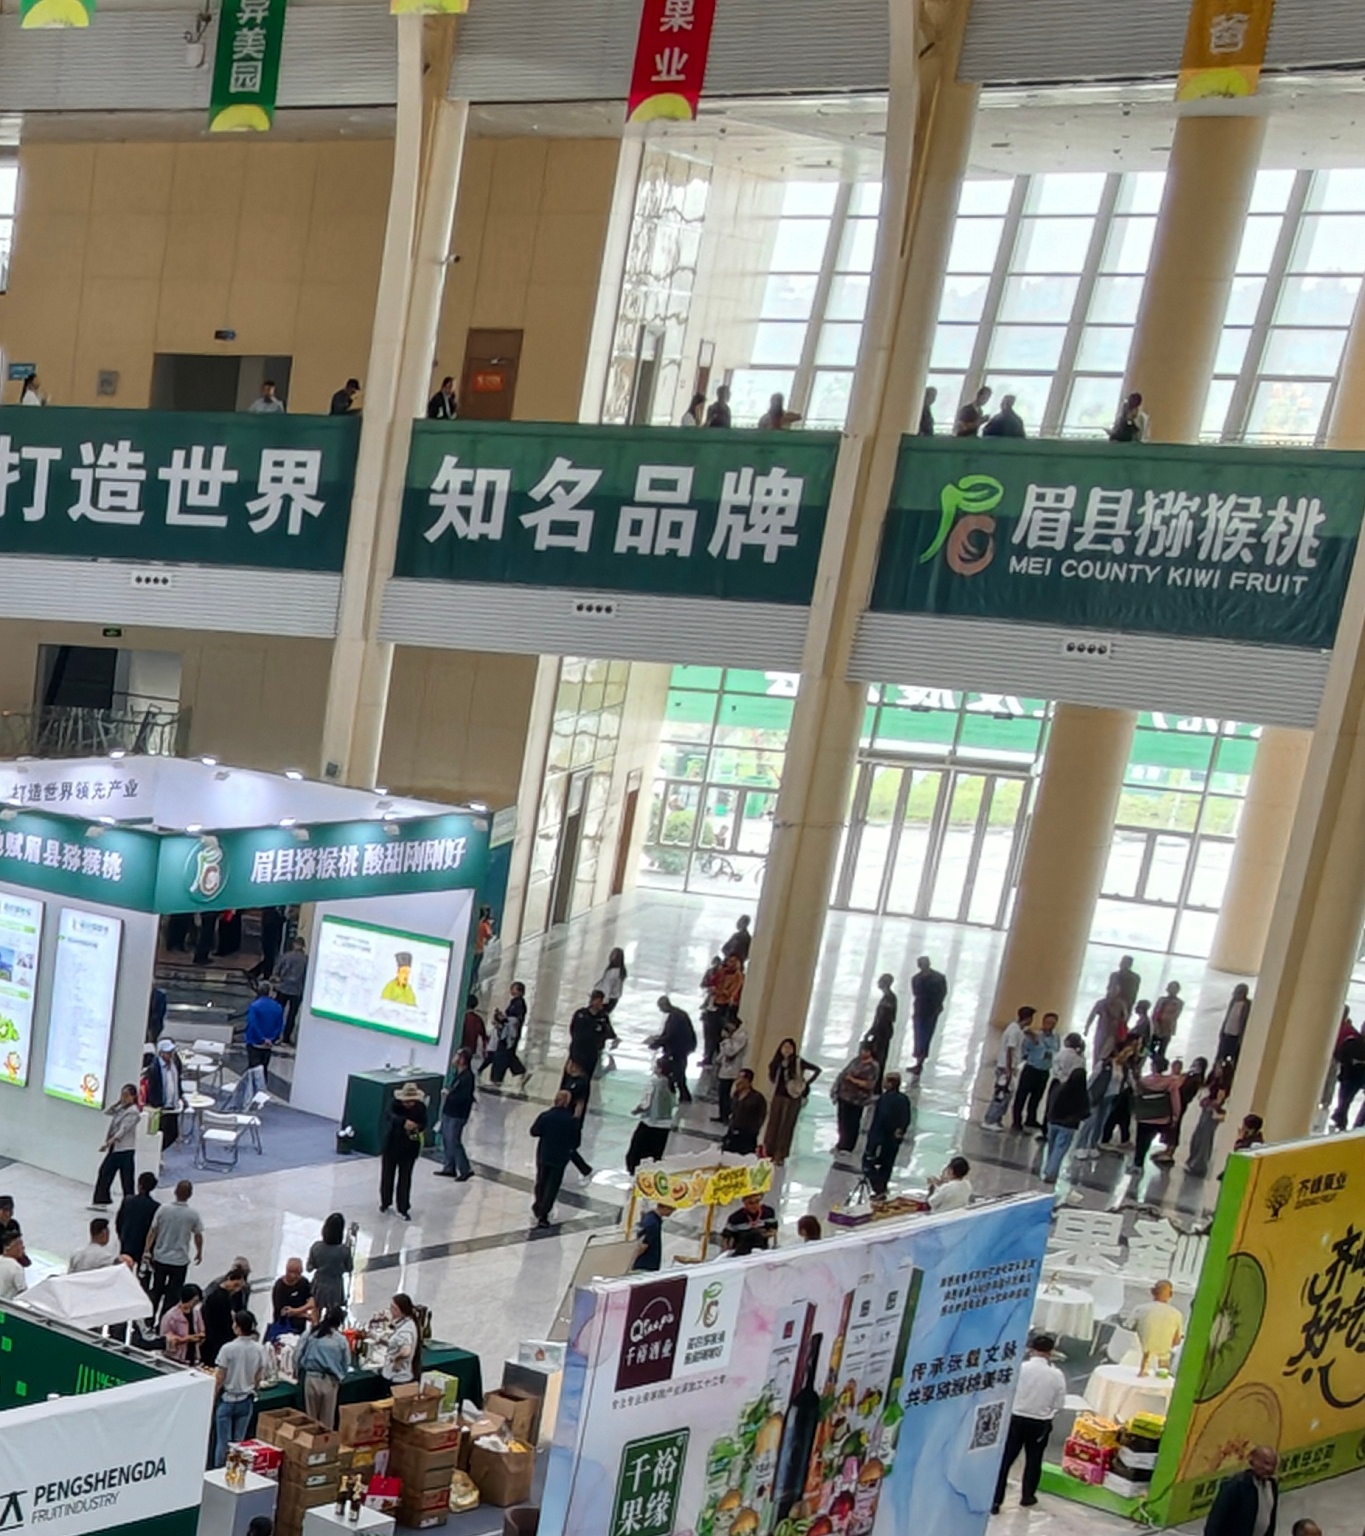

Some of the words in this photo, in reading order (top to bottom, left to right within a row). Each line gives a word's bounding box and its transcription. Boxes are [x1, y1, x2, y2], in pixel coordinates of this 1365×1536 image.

[422, 455, 805, 563] 知名品牌
[1009, 482, 1327, 568] 眉县猕猴桃
[1009, 556, 1051, 576] MEI
[1060, 558, 1161, 585] COUNTY
[1168, 563, 1222, 589] KIWI
[1229, 567, 1308, 596] FRUIT
[250, 845, 360, 885] 眉县猕猴桃
[362, 836, 468, 879] 酸甜刚刚好
[33, 1456, 168, 1507] PENGSHENGDA
